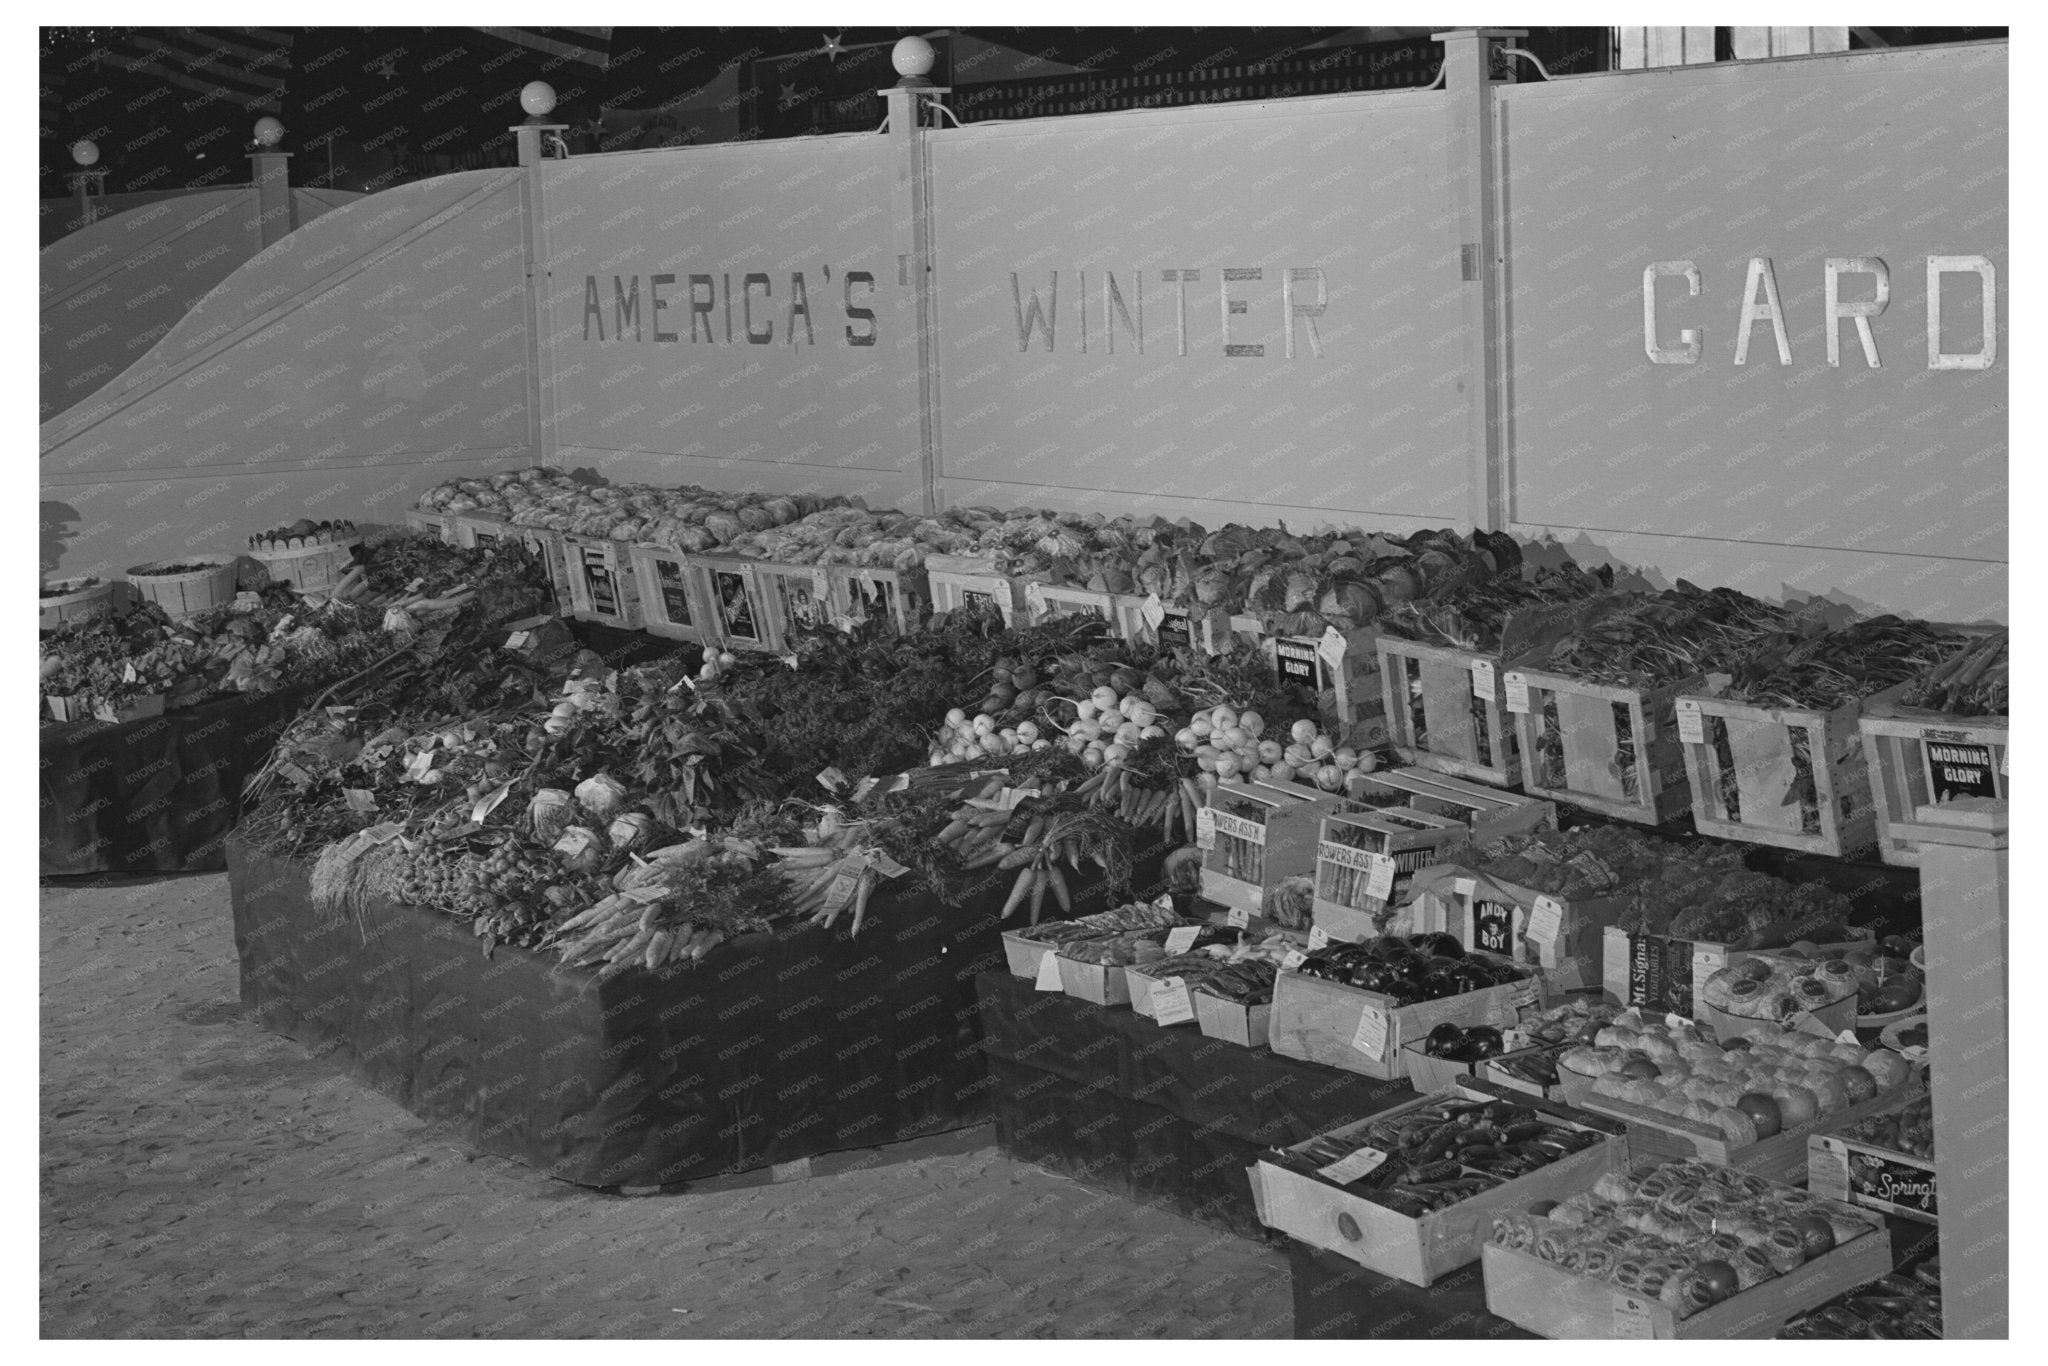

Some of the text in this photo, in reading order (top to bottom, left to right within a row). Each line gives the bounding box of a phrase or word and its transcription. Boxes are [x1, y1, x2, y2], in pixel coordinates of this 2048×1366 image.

[583, 254, 1997, 371] AMERICA'S WINTER GARD
[1277, 643, 1315, 663] MORNING
[1285, 661, 1310, 677] GLORY
[1930, 745, 1989, 766] MORNING
[1943, 767, 1982, 785] GLORY
[1393, 850, 1432, 873] WINTER
[1480, 902, 1508, 924] ANDY
[1481, 929, 1505, 949] BOY
